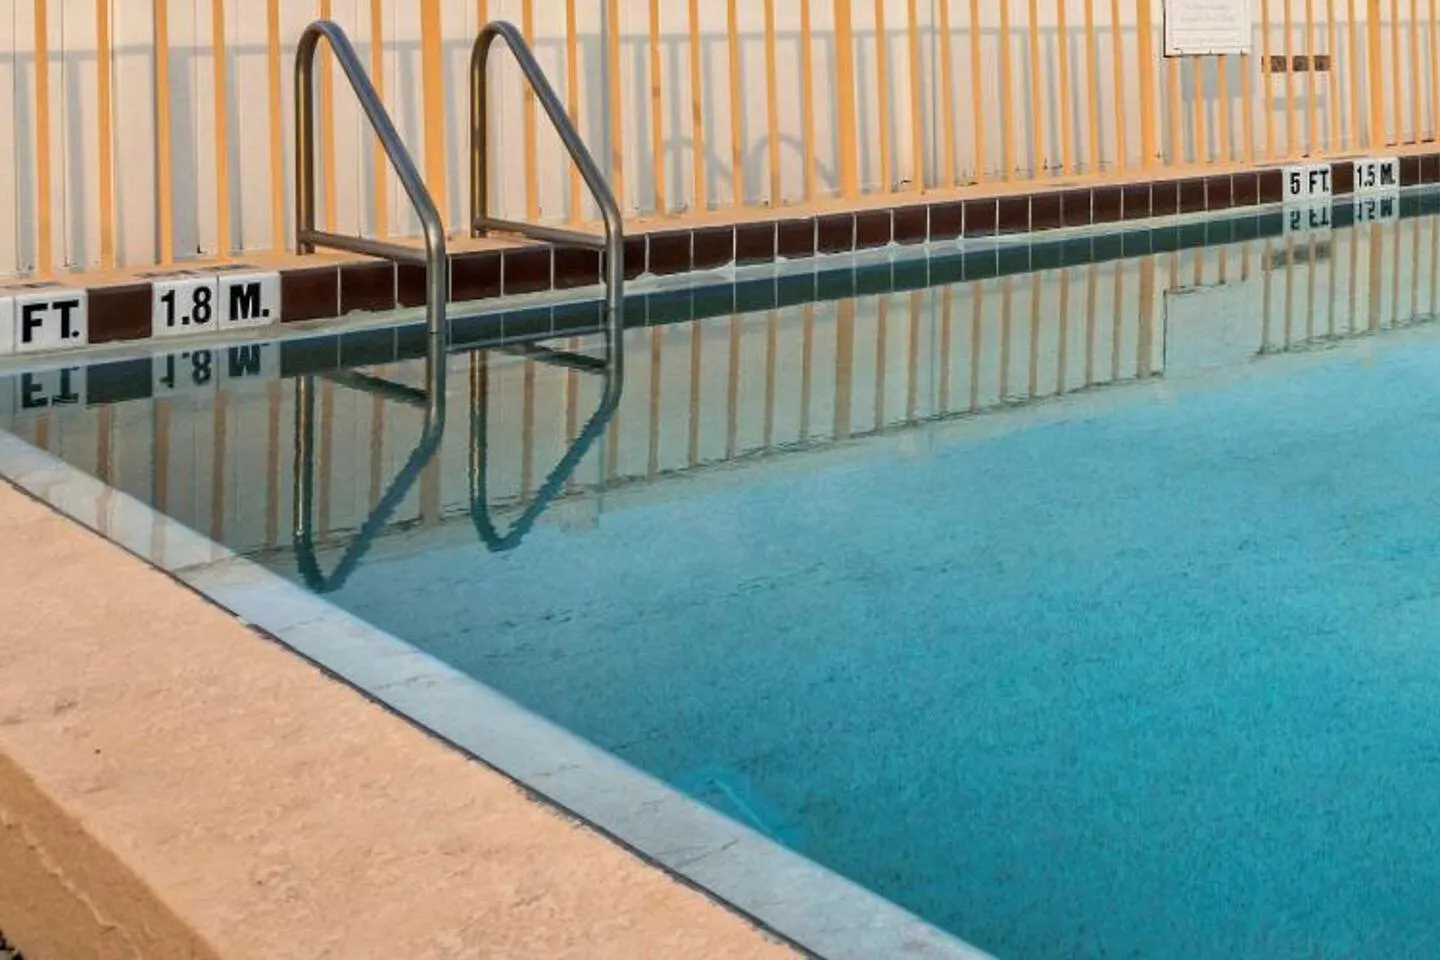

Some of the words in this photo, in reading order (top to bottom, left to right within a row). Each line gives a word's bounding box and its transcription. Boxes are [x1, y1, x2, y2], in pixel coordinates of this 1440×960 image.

[1290, 172, 1300, 194] 5
[1309, 168, 1329, 193] FT.
[1357, 164, 1375, 188] 1.5
[22, 299, 80, 343] FT.
[161, 286, 212, 327] 1.8
[229, 282, 270, 321] M.
